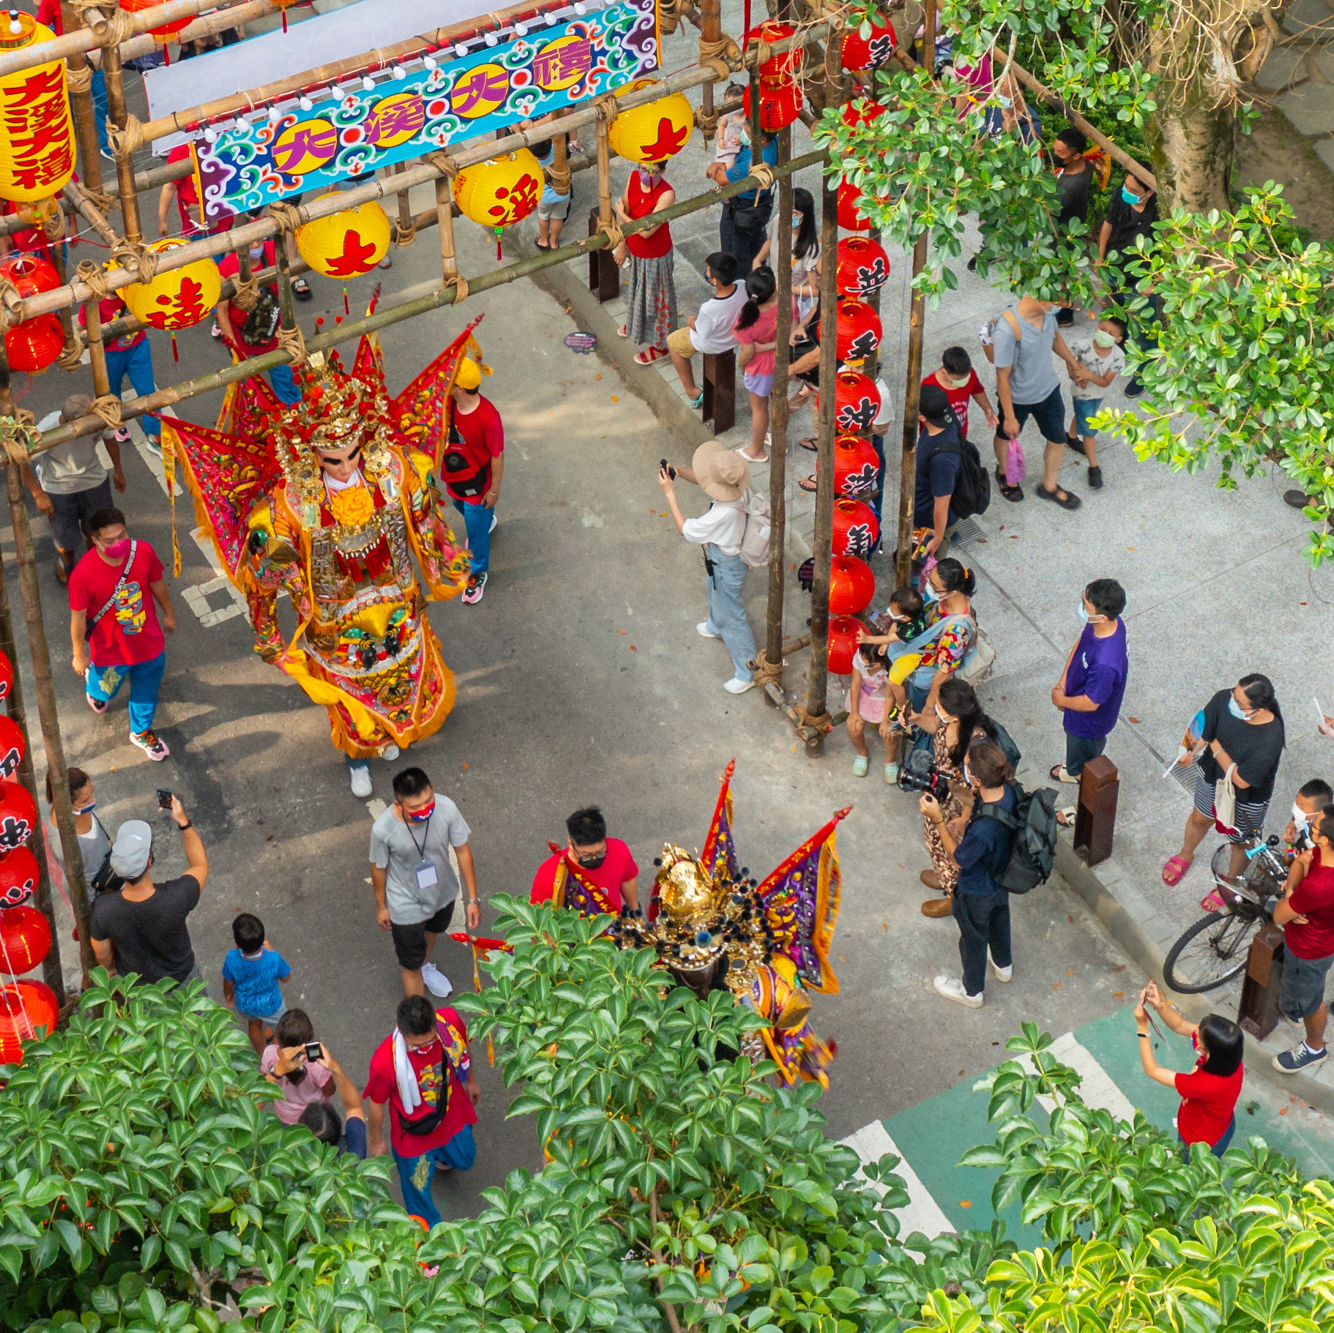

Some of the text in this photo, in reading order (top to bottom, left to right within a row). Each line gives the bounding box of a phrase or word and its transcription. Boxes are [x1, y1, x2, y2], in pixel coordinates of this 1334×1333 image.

[2, 63, 74, 189] 大溪大禧
[271, 37, 592, 173] 大溪大禧
[640, 116, 687, 162] 大
[487, 173, 539, 227] 溪
[324, 229, 376, 277] 大
[145, 276, 211, 331] 禧
